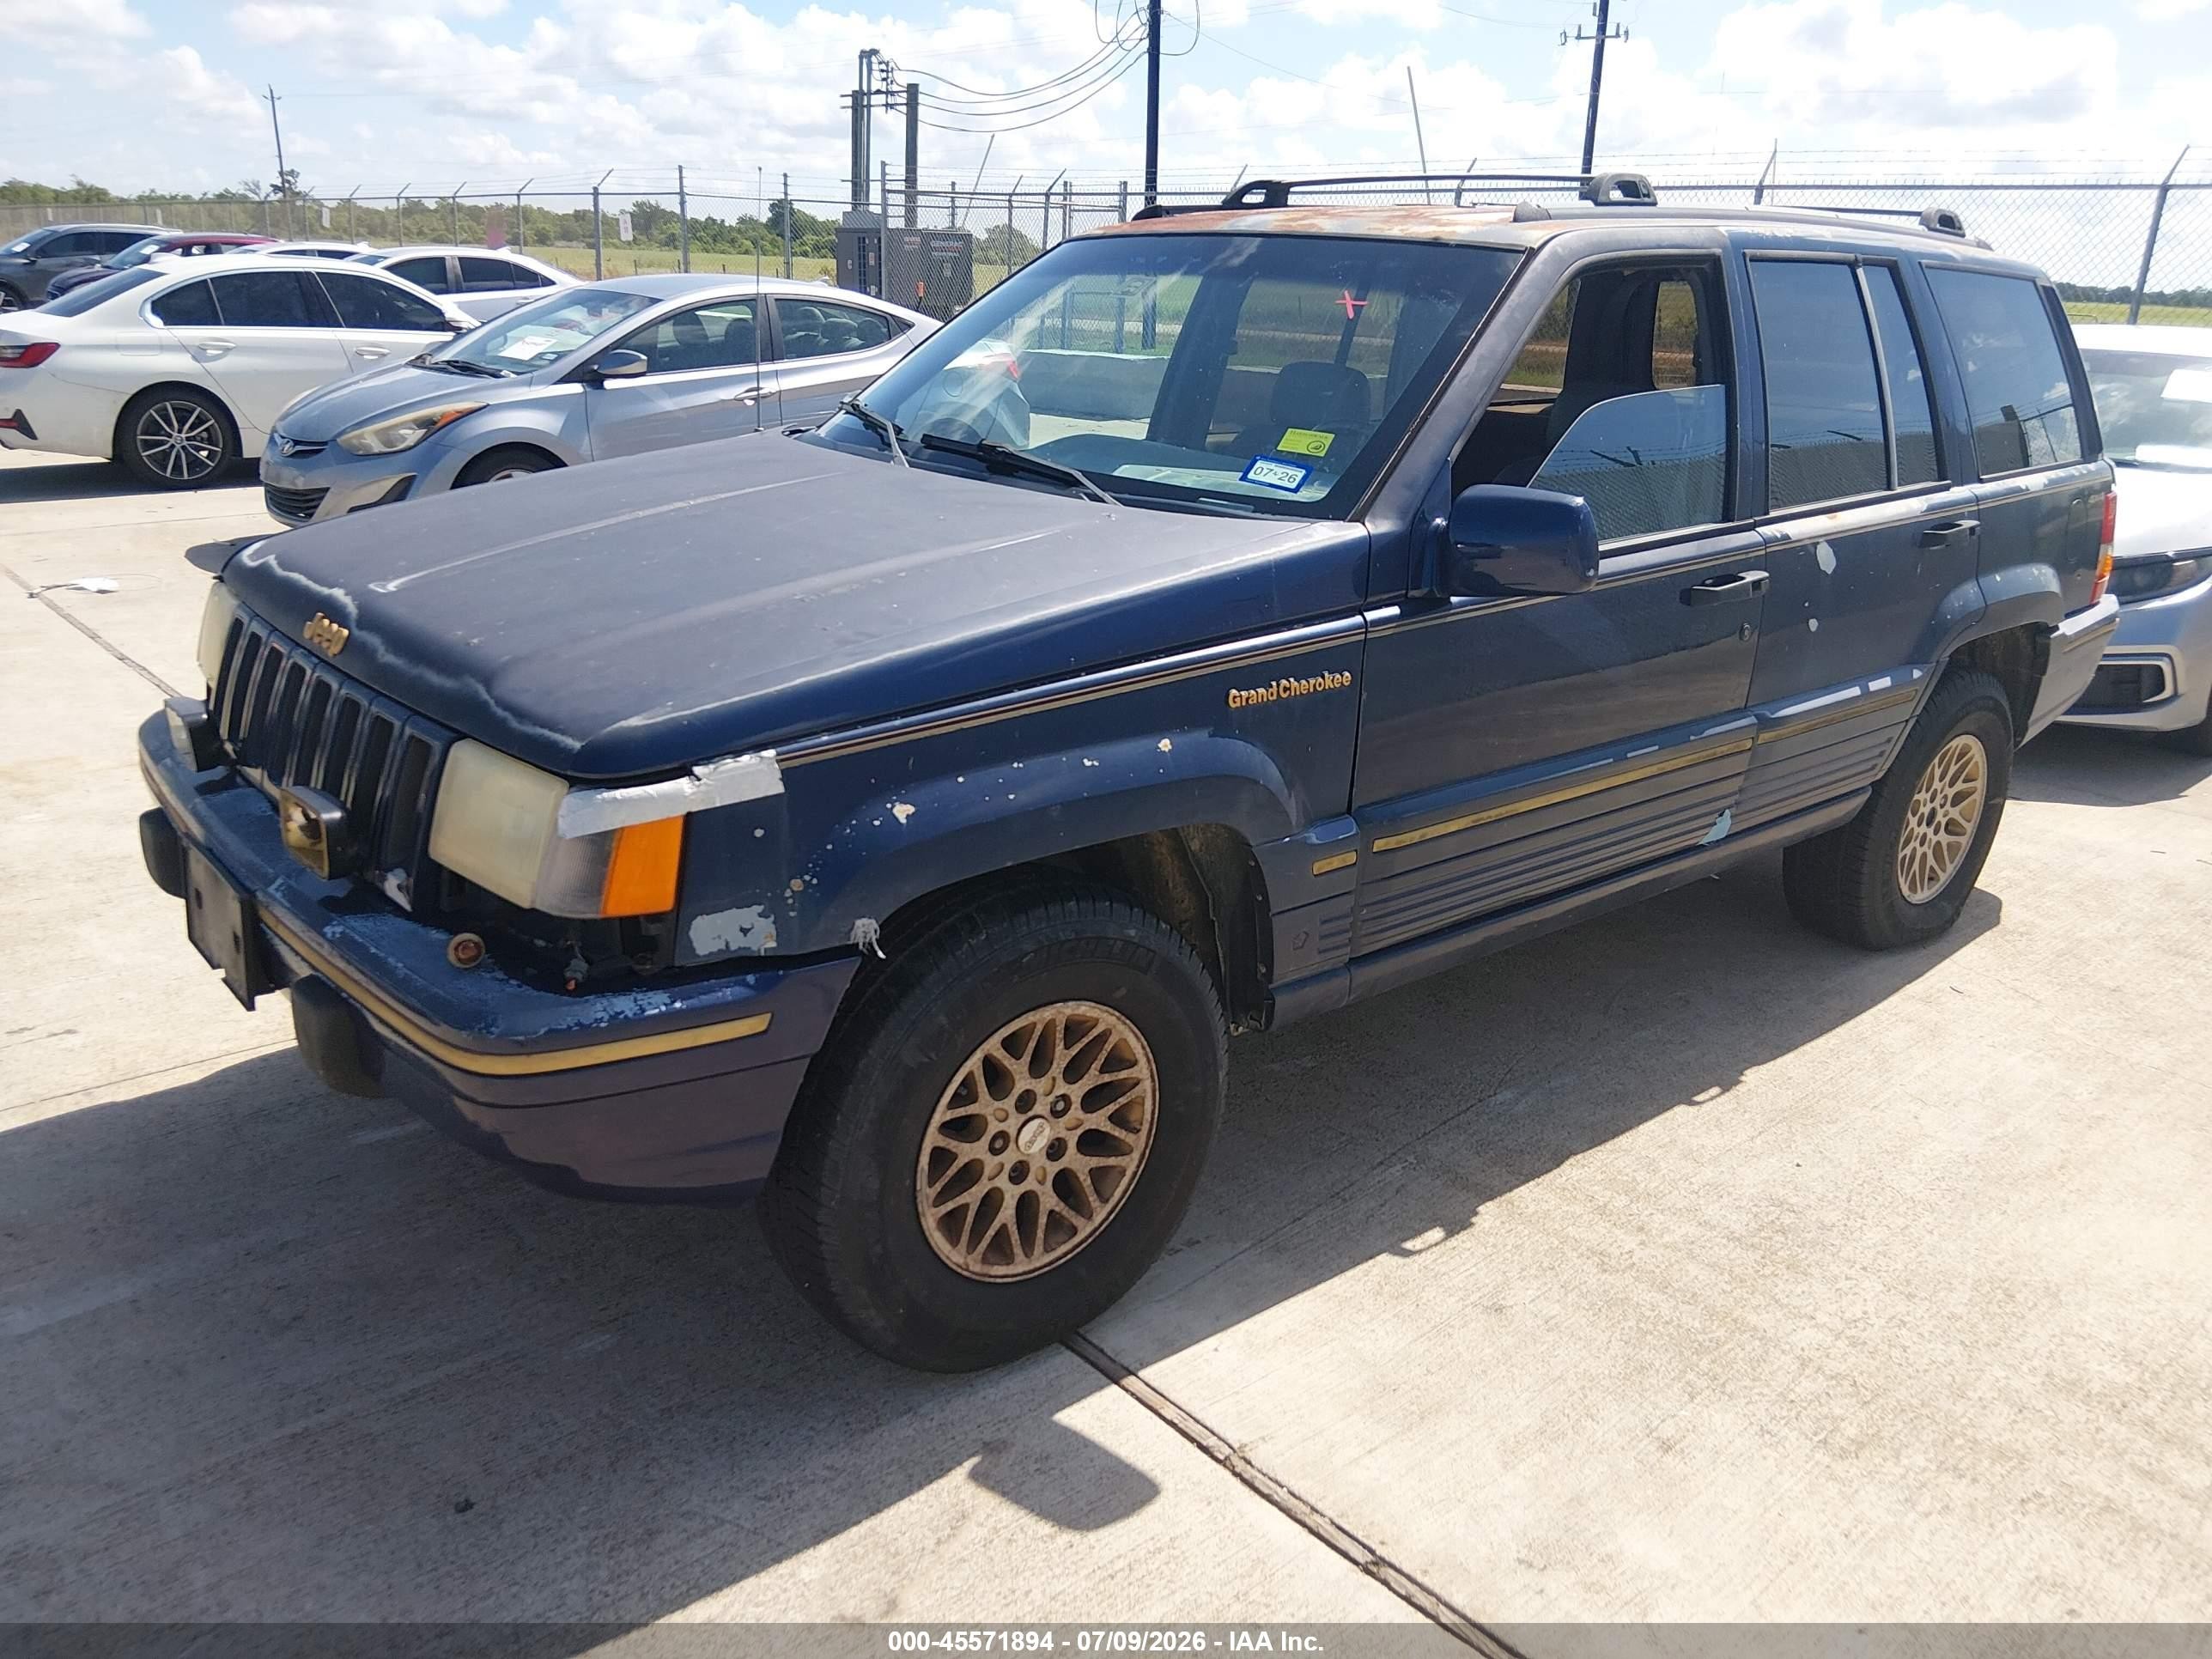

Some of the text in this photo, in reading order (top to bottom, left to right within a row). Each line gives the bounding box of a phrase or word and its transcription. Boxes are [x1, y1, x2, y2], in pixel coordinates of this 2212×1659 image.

[1253, 466, 1298, 483] 07 26
[303, 612, 349, 657] Jeep
[1228, 671, 1352, 708] Grand Cherokee
